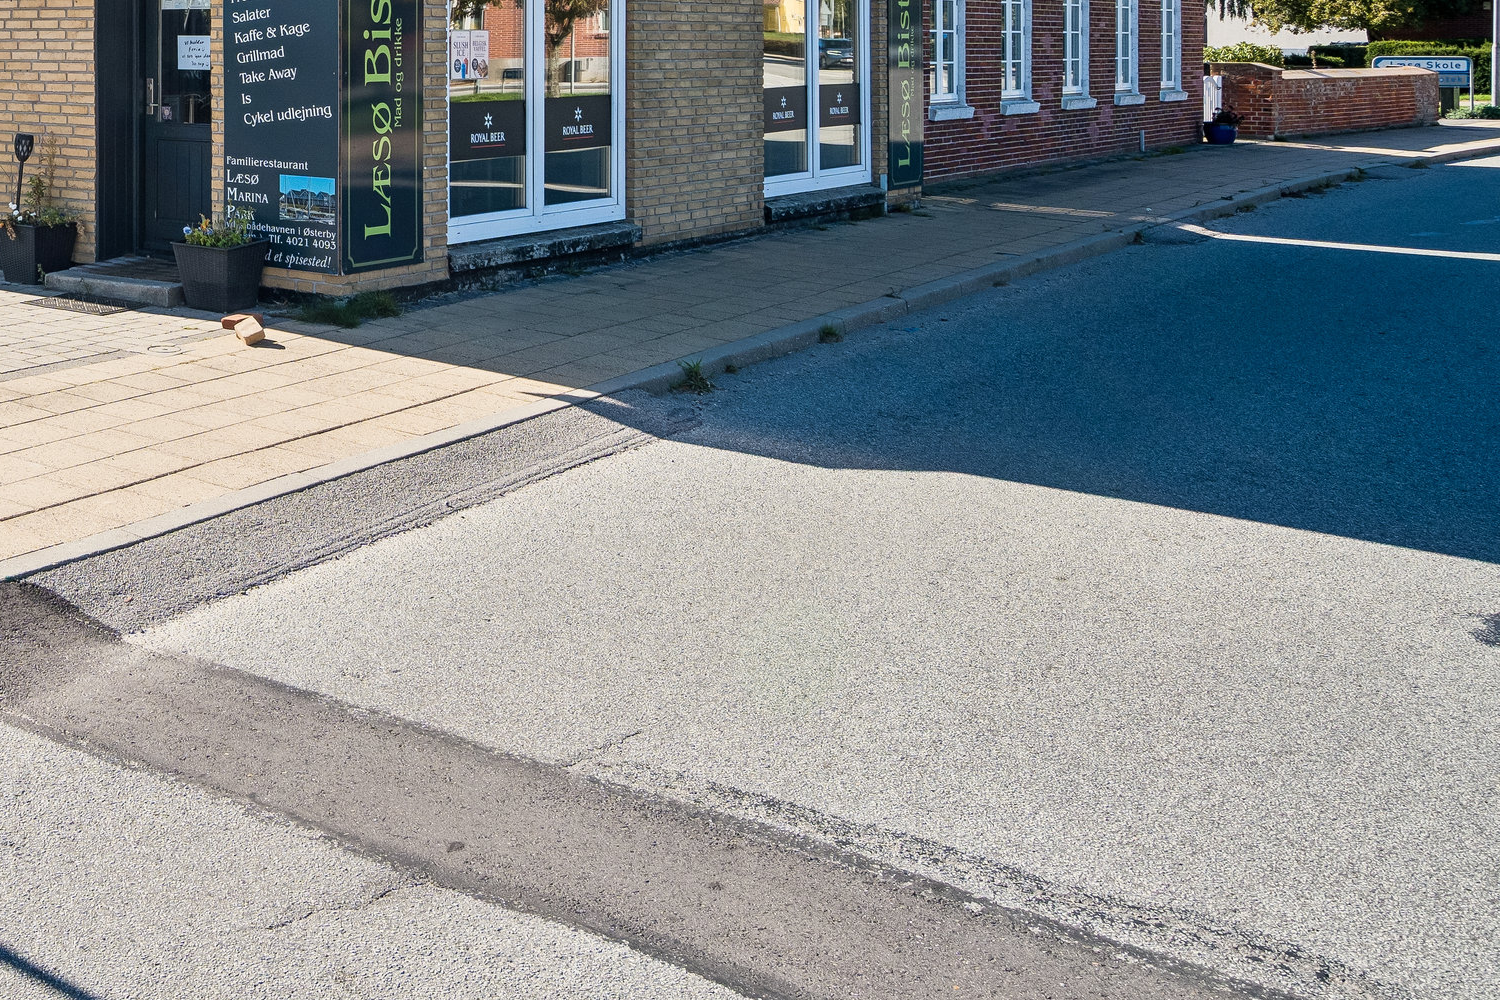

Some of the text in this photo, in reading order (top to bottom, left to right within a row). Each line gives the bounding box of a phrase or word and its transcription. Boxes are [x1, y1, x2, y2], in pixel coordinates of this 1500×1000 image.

[232, 8, 271, 24] Salater
[234, 22, 310, 44] Kaffe & Kage
[237, 45, 285, 64] Grillmad
[394, 17, 404, 127] Mad og drikke
[1426, 61, 1461, 69] Skole
[239, 67, 297, 84] Take Away
[241, 93, 252, 104] Is
[243, 105, 332, 127] Cykel udlejning
[470, 131, 506, 143] ROYAL BEER
[562, 124, 594, 136] ROYAL BEER
[226, 155, 309, 171] Familierestaurant
[303, 227, 337, 240] Østerby
[268, 234, 283, 244] Tlf.
[286, 236, 309, 247] 4021
[312, 239, 337, 250] 4093
[273, 252, 283, 261] et
[285, 253, 332, 269] spisested!
